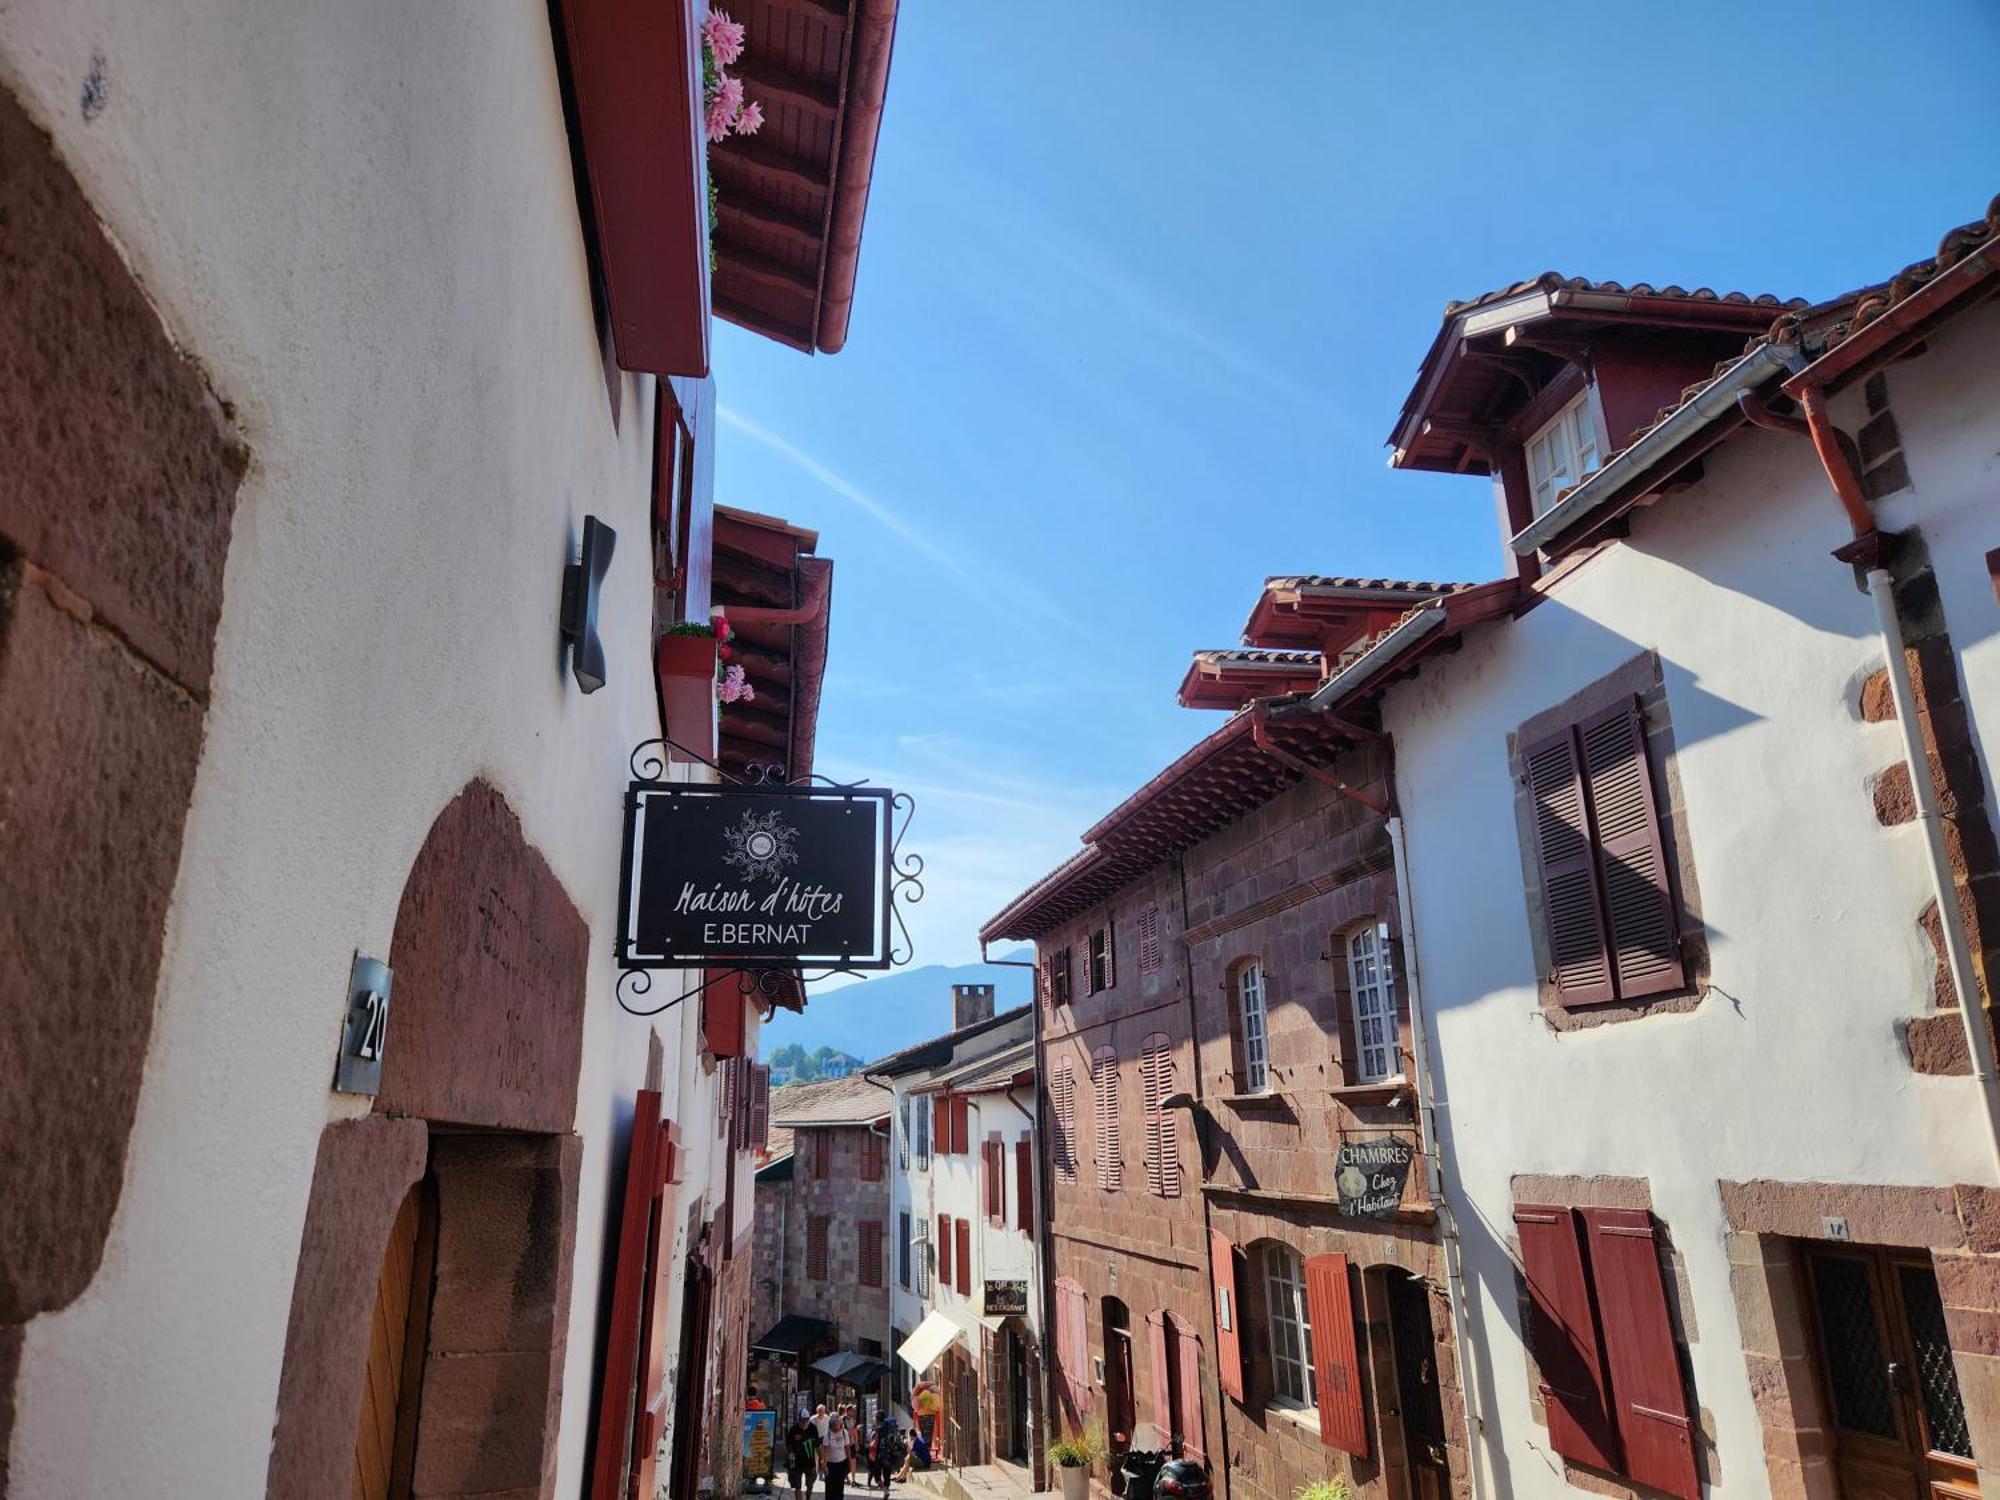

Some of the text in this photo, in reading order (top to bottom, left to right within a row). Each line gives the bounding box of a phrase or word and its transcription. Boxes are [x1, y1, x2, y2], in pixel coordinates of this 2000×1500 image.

[673, 877, 844, 921] Maison d'hôtes
[703, 923, 812, 944] E.BERNAT
[360, 991, 388, 1062] 20
[1342, 1147, 1409, 1164] CHAMBRES
[1372, 1173, 1397, 1191] Chez
